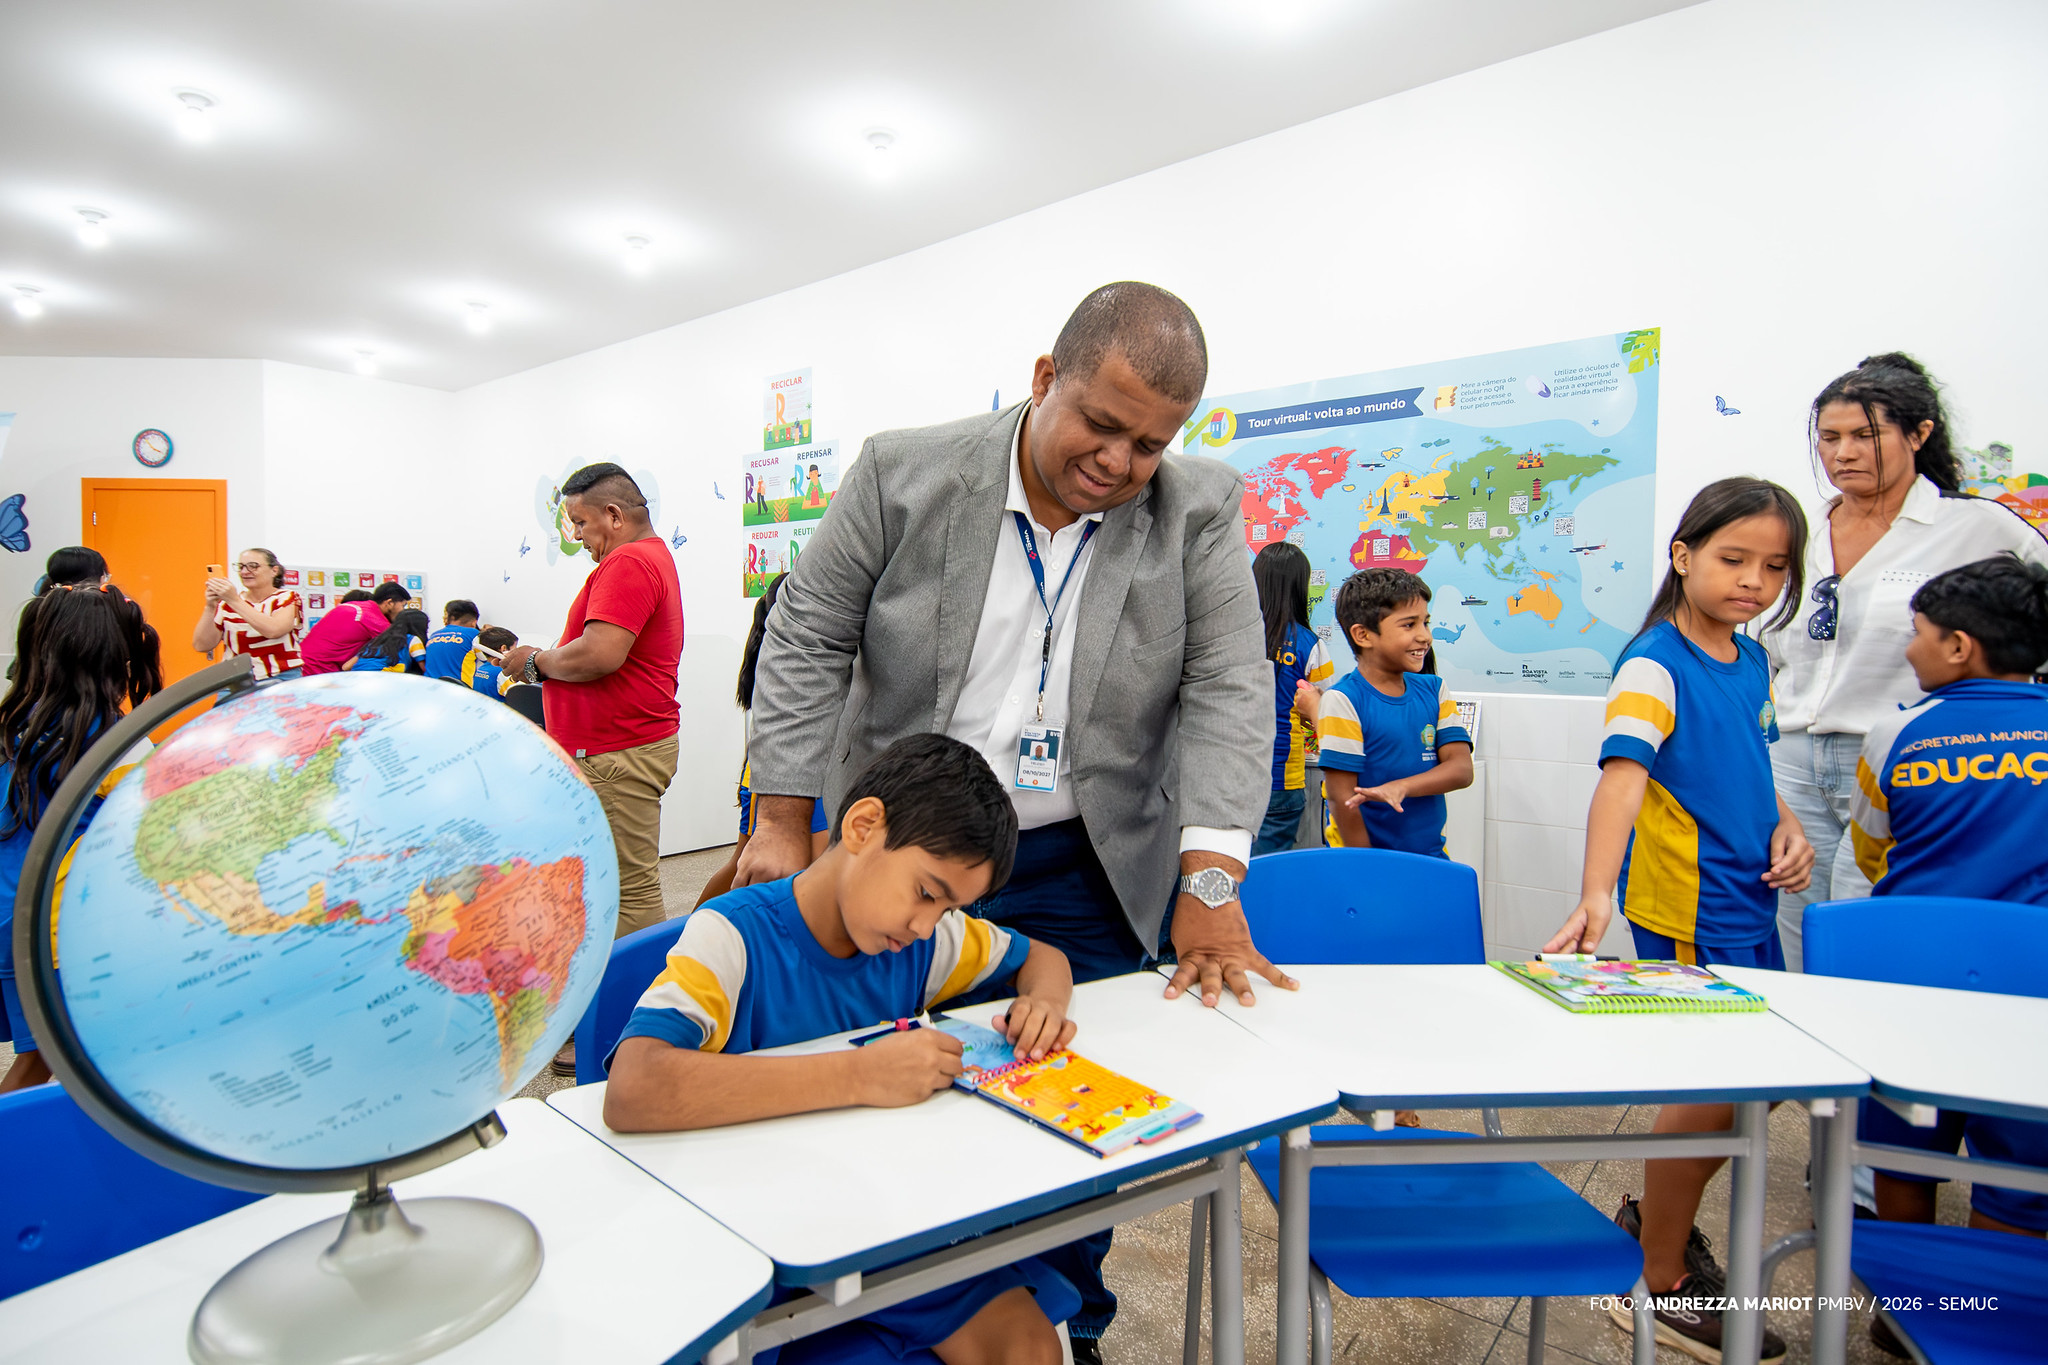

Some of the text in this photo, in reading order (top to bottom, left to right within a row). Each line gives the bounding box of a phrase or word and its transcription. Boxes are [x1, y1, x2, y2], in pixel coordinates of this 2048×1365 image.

[1554, 368, 1577, 376] Utilize
[1585, 364, 1609, 372] óculos
[1554, 370, 1612, 383] realidade virtual
[771, 376, 803, 390] RECICLAR
[1553, 384, 1570, 392] para
[1461, 388, 1483, 396] celular
[1494, 384, 1505, 392] QR
[1571, 388, 1591, 396] ainda
[776, 393, 787, 426] R
[1475, 401, 1490, 409] pelo
[1248, 398, 1406, 429] Tour virtual: volta ao mundo
[797, 447, 832, 461] REPENSAR
[750, 457, 779, 469] RECUSAR
[751, 530, 779, 540] REDUZIR
